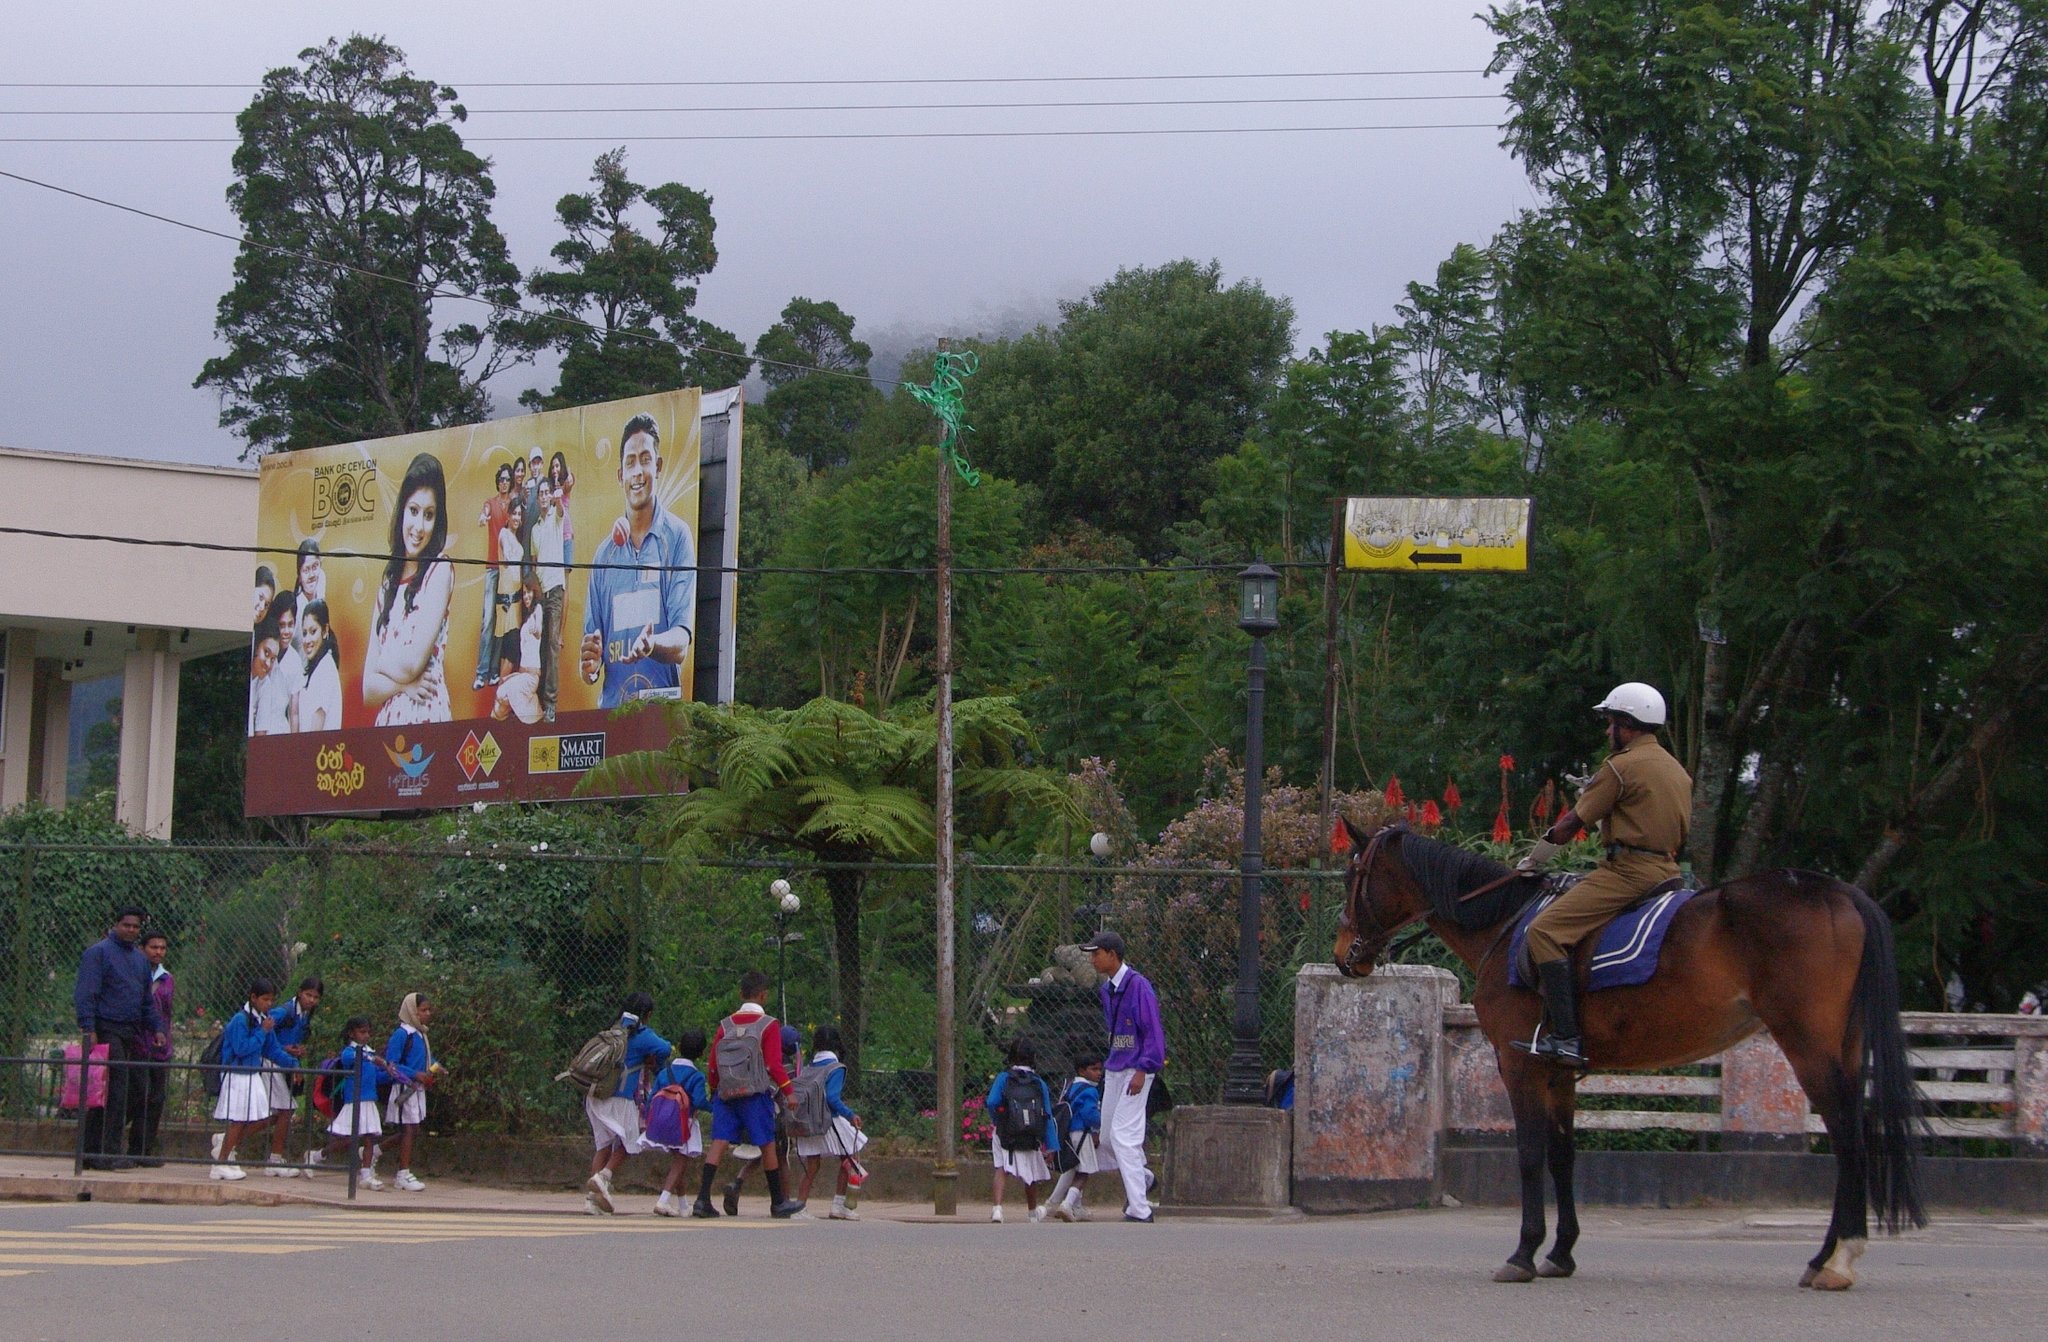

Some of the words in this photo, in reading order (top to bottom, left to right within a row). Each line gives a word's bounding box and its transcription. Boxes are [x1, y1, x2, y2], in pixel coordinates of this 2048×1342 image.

[314, 466, 334, 477] BANK
[336, 463, 347, 474] OF
[347, 459, 377, 472] CEYLON
[312, 469, 376, 519] BOC
[316, 743, 346, 771] රන්
[463, 745, 474, 765] 18
[533, 745, 556, 763] BOC
[561, 739, 602, 757] SMART
[561, 755, 601, 768] INVESTOR
